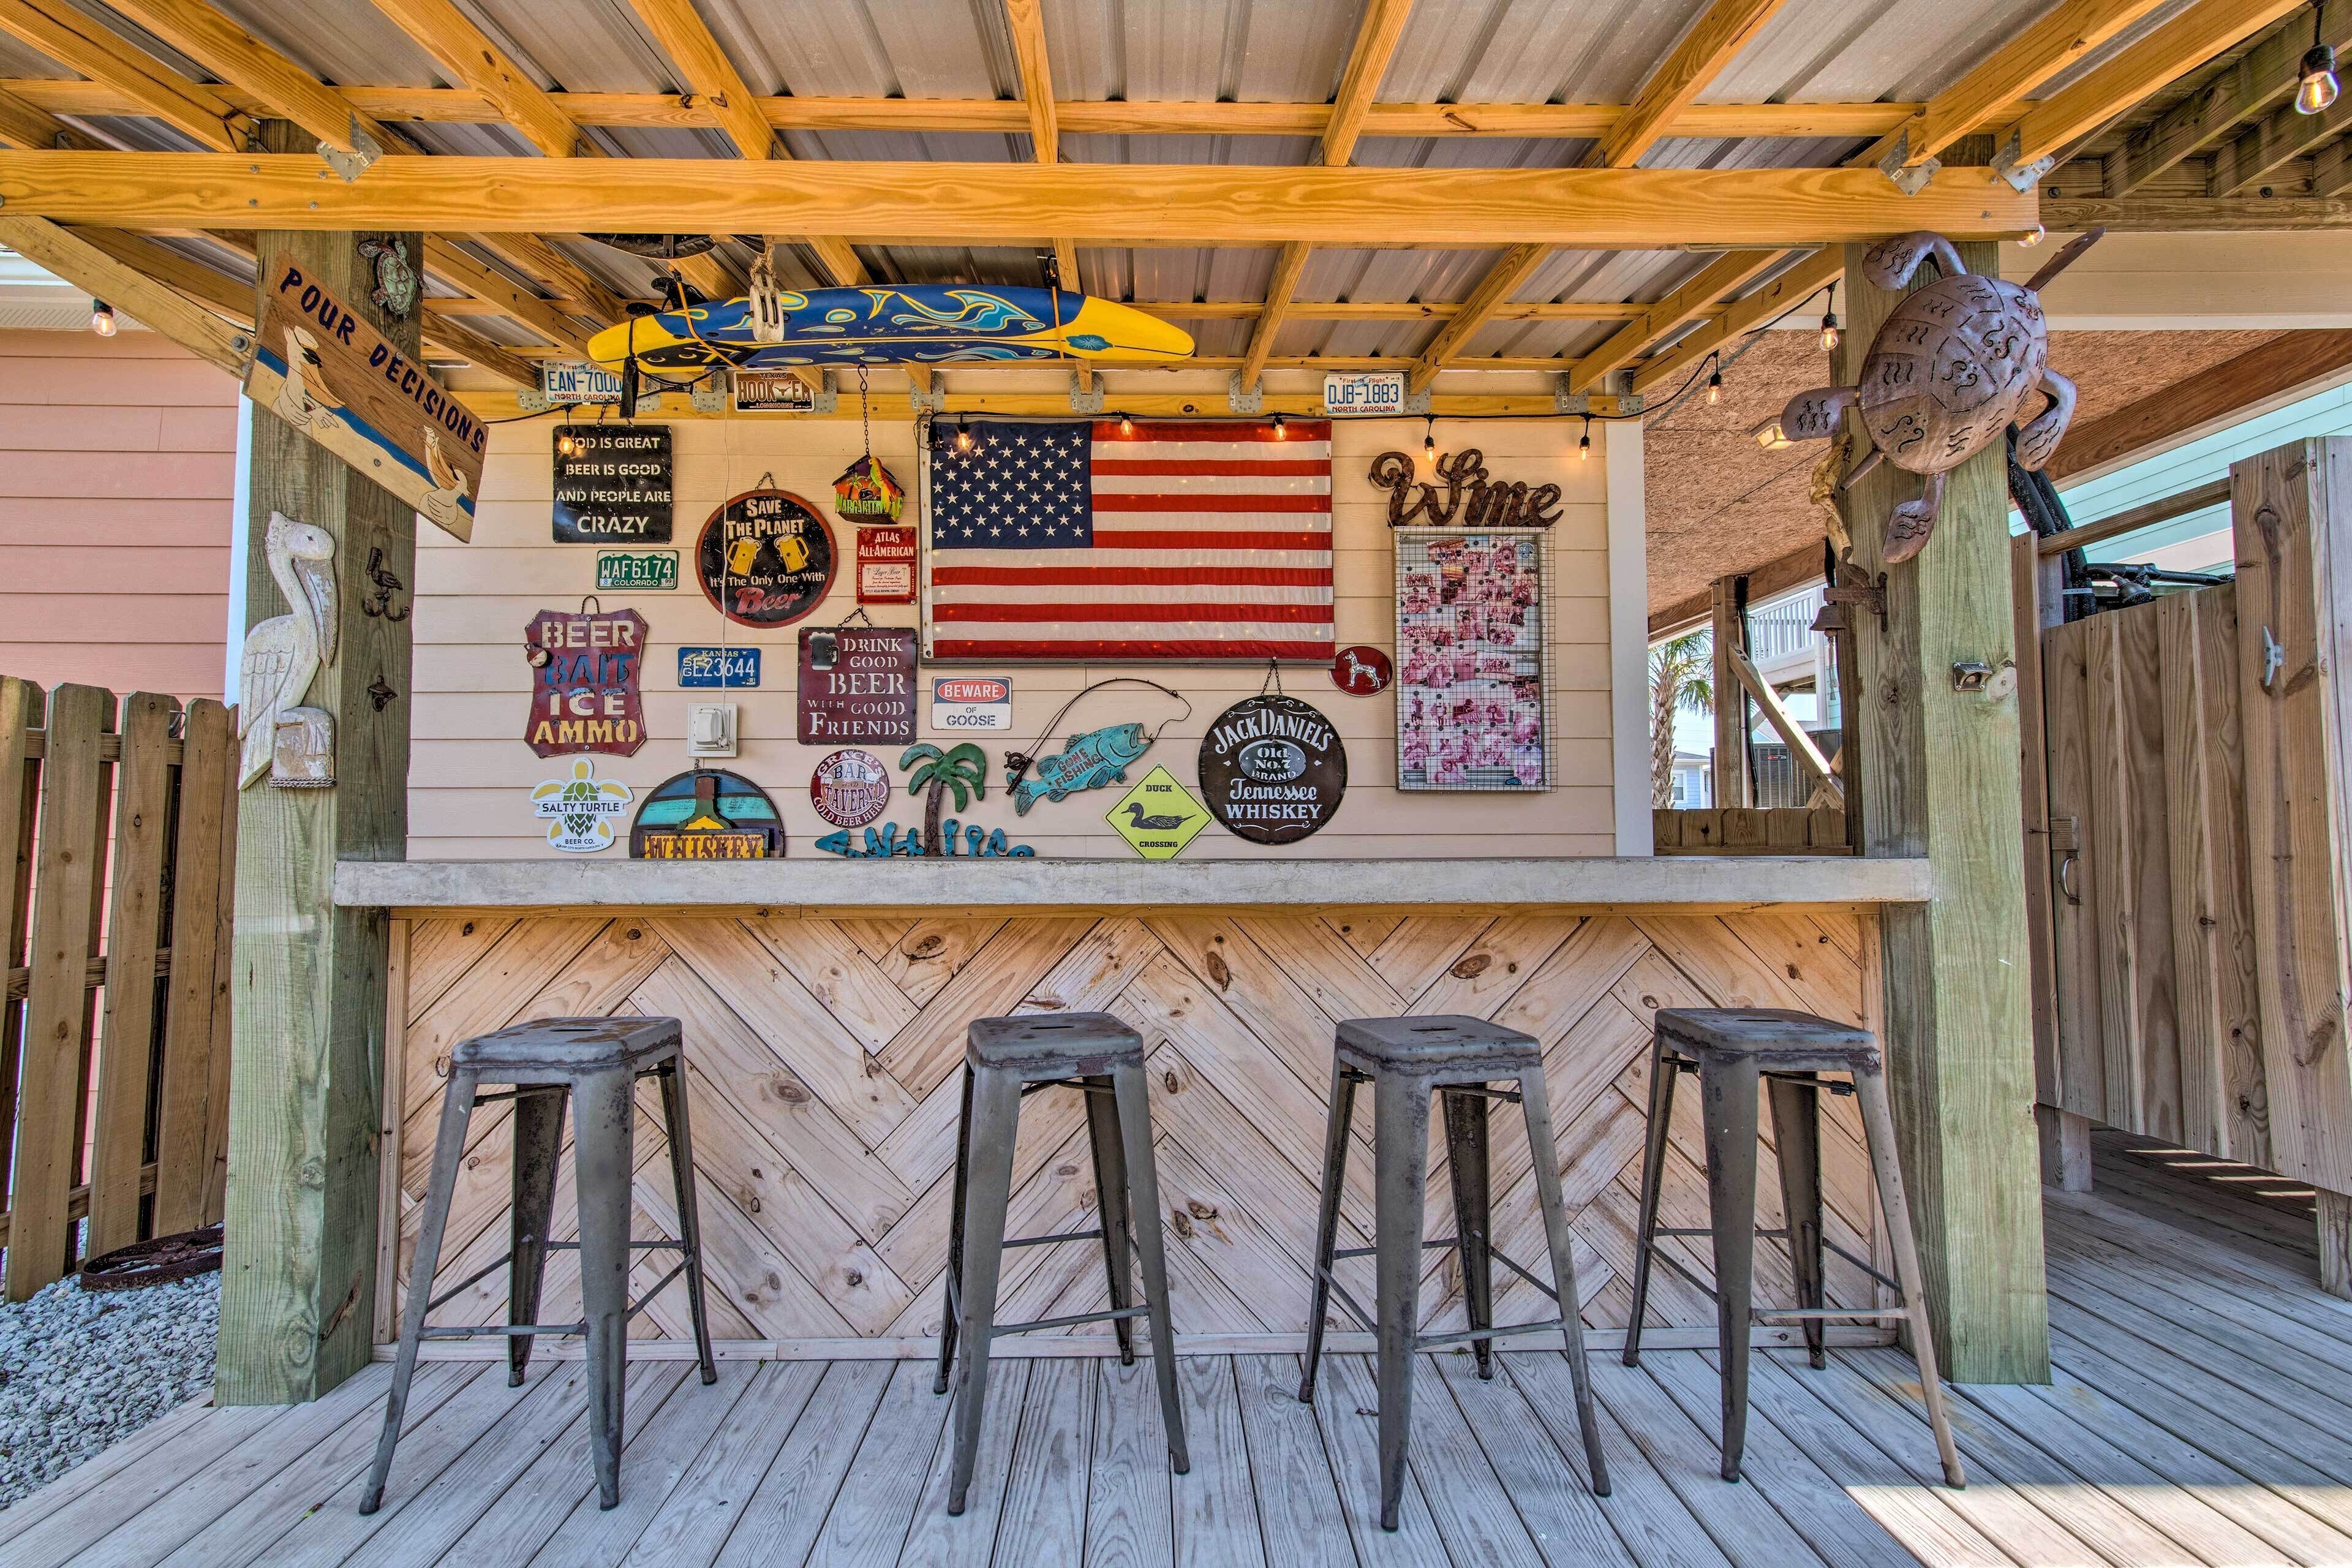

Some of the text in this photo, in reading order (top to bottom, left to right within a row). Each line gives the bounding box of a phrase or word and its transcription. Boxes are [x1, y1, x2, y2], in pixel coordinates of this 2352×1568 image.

[280, 267, 484, 453] POUR DECISIONS
[548, 371, 622, 392] EAN-7000
[737, 381, 776, 402] HOOK
[1329, 383, 1399, 404] DJB-1883
[570, 437, 660, 449] OD IS GREAT
[566, 464, 661, 475] BEER IS GOOD
[556, 491, 671, 502] AND PEOPLE ARE
[1368, 448, 1564, 527] Wine
[577, 516, 649, 533] CRAZY
[875, 531, 900, 544] ATLAS
[601, 560, 672, 578] WAF6174
[710, 572, 825, 587] It's The Only One With
[735, 587, 804, 614] Beer
[541, 620, 636, 649] BEER
[843, 638, 903, 652] DRINK
[544, 652, 636, 685] BAIT
[850, 656, 899, 668] GOOD
[828, 673, 907, 695] BEER
[944, 684, 1000, 698] BEWARE
[548, 686, 628, 716] ICE
[807, 699, 907, 715] WITH GOOD
[946, 715, 995, 726] GOOSE
[1213, 708, 1334, 754] JACK DANIEL'S
[533, 719, 638, 744] AMMO
[1057, 747, 1089, 772] GONE
[1257, 747, 1288, 758] Old
[817, 751, 885, 777] GRACE'S
[833, 763, 867, 780] BAR
[1054, 753, 1101, 788] FISHING
[1251, 770, 1297, 781] BRAND
[825, 786, 877, 813] TAVERN
[1230, 778, 1317, 801] Tennessee
[542, 802, 619, 812] SALTY TURTLE
[813, 797, 886, 827] COLD BEER HERE
[1225, 804, 1323, 819] WHISKEY
[646, 836, 761, 858] WHISKEY
